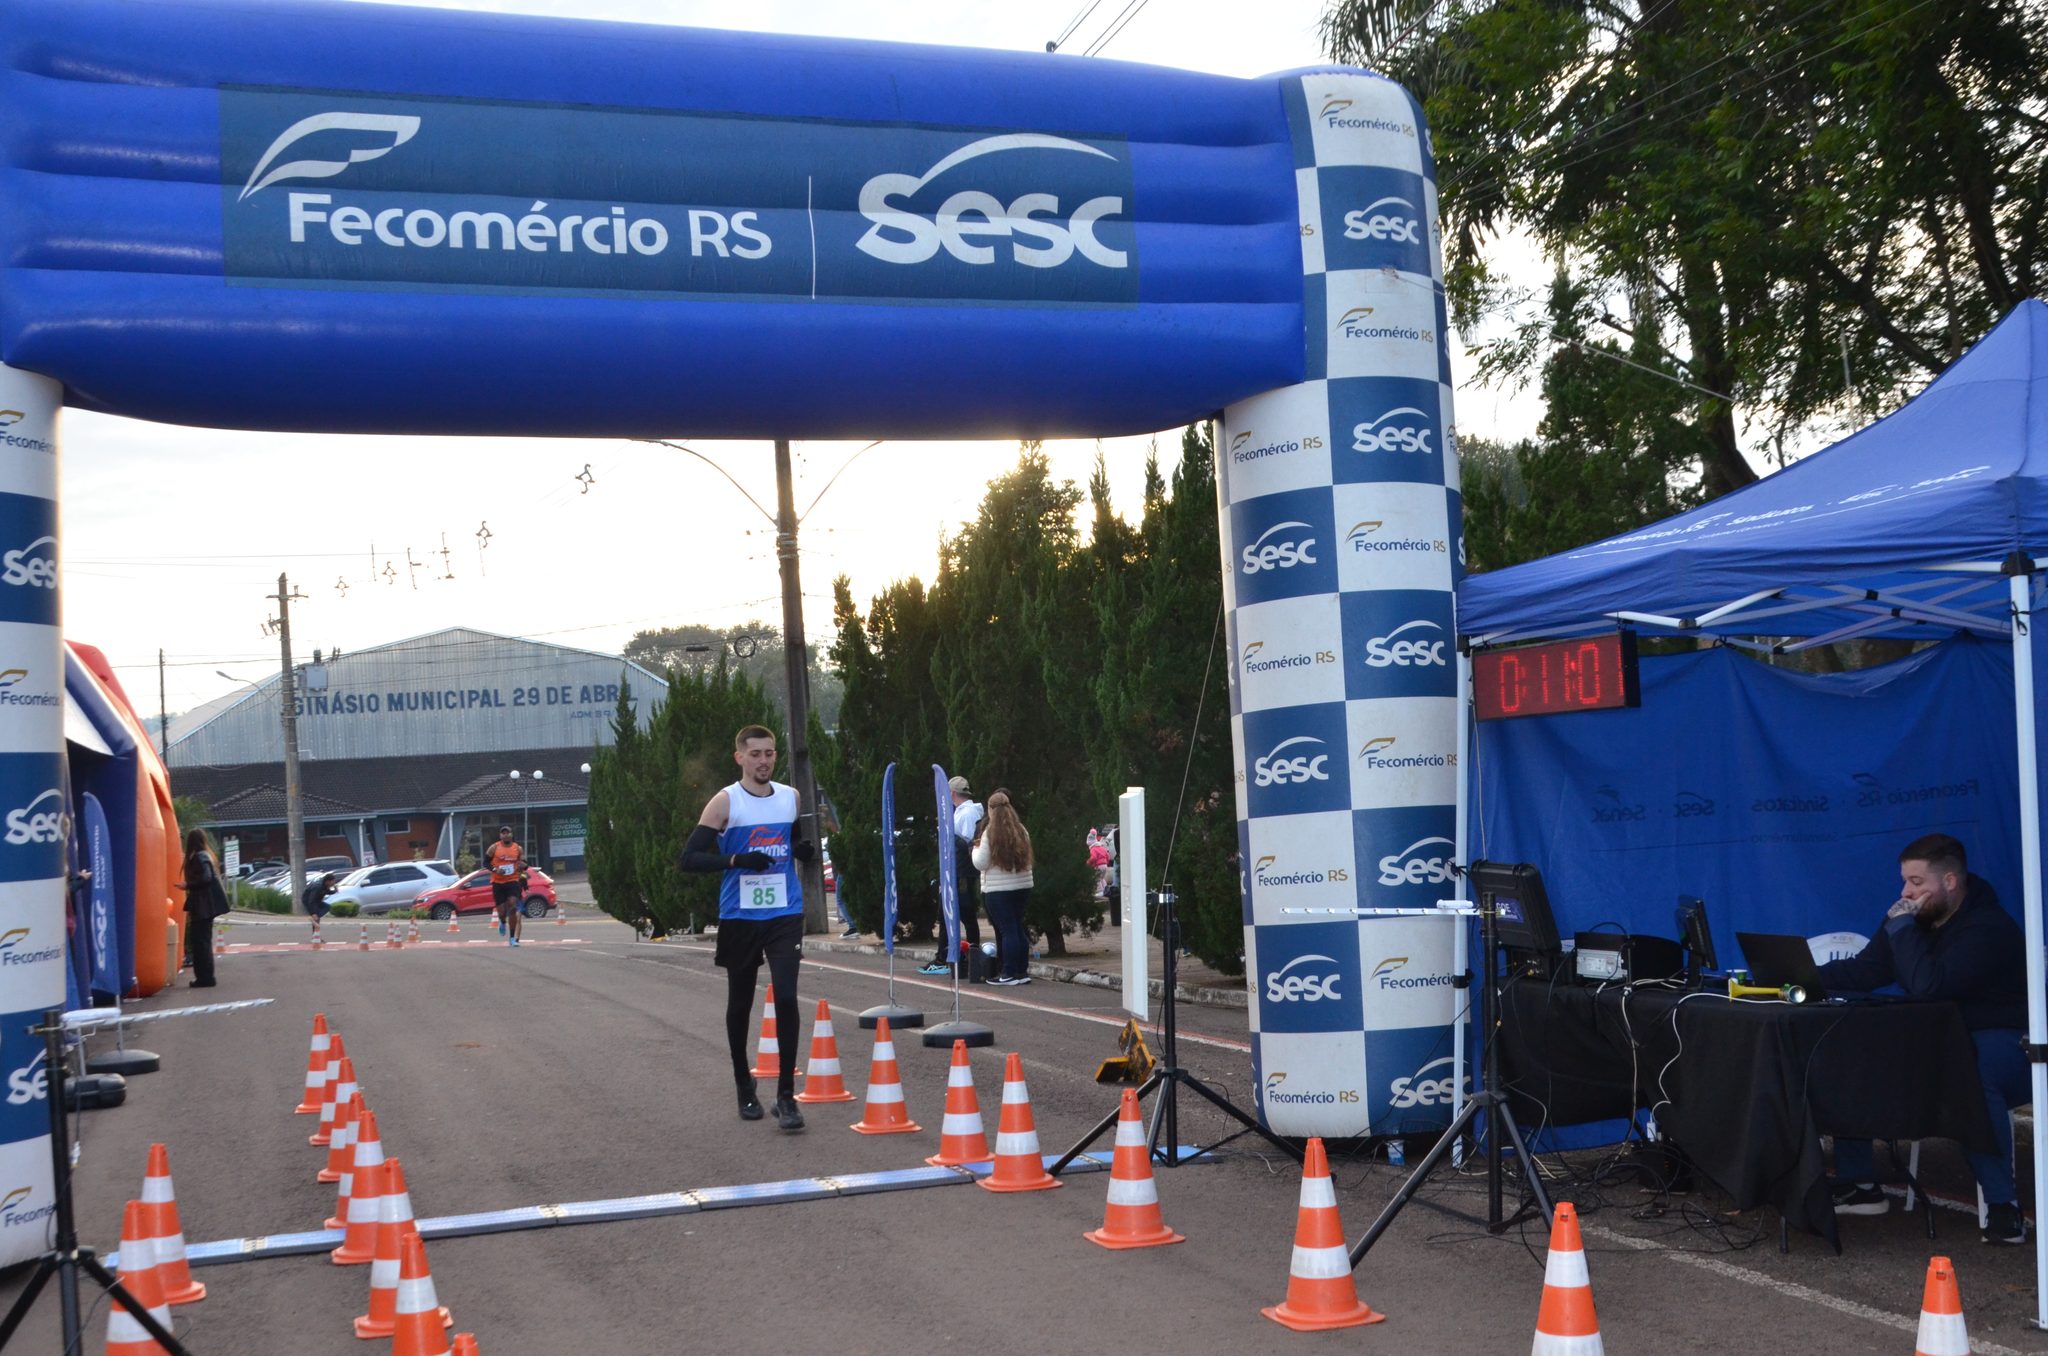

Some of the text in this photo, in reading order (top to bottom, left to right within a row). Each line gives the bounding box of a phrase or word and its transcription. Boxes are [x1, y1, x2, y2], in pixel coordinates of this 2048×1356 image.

[1329, 116, 1415, 138] Fecomércio RS
[855, 133, 1128, 269] Sesc
[289, 192, 772, 260] Fecomércio RS
[1344, 197, 1420, 245] Sesc
[1346, 321, 1434, 343] Fecomércio RS
[1352, 407, 1433, 454] Sesc
[1234, 436, 1323, 464] Fecomércio RS
[1242, 521, 1317, 575] Sesc
[1355, 537, 1431, 553] Fecomércio
[1433, 540, 1446, 553] RS
[1365, 619, 1446, 668] Sesc
[1246, 651, 1312, 674] Fecomércio
[1315, 650, 1336, 664] RS
[387, 689, 506, 712] MUNICIPAL
[513, 687, 540, 706] 29
[547, 686, 573, 705] DE
[580, 684, 639, 704] ABRL
[1254, 736, 1329, 788] Sesc
[1368, 754, 1444, 769] Fecomércio
[1258, 867, 1348, 887] Fecomércio RS
[753, 887, 775, 906] 85
[1266, 954, 1342, 1003] Sesc
[1269, 1089, 1359, 1105] Fecomércio RS
